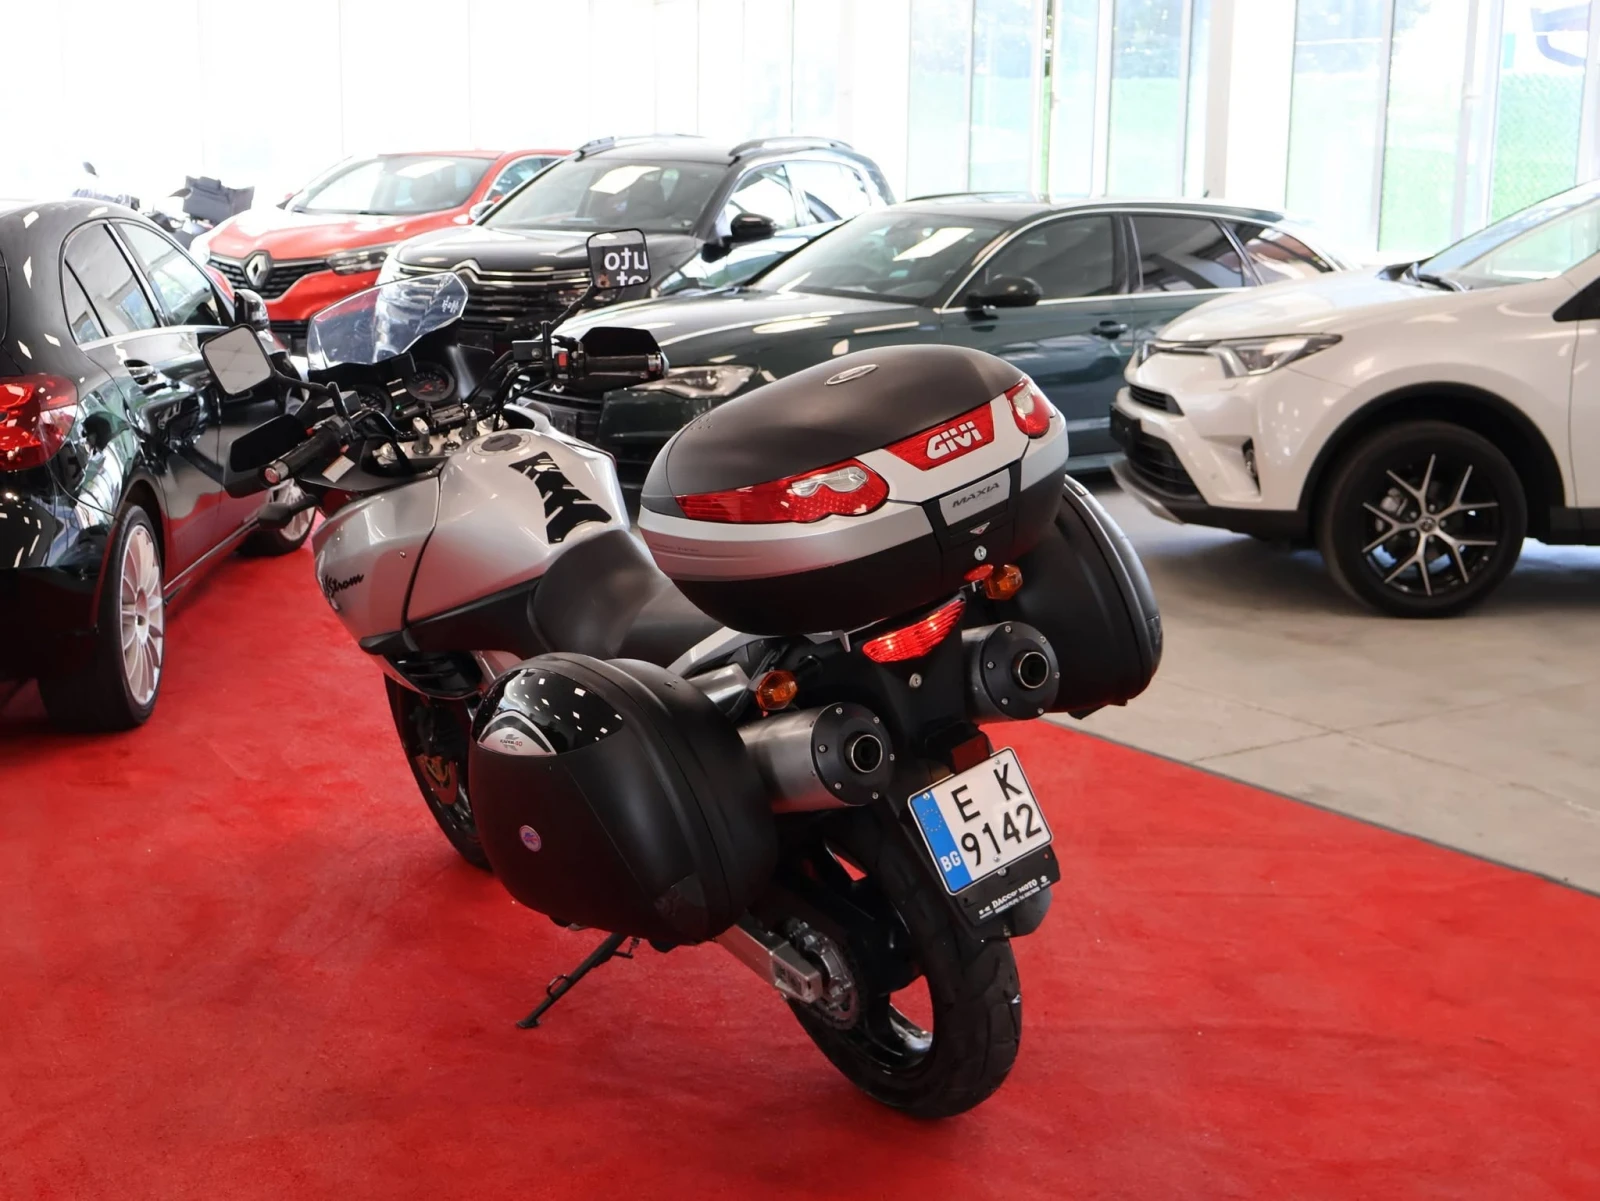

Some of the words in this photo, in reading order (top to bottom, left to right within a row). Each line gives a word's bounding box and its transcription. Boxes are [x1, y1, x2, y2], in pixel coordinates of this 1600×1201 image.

[926, 420, 983, 460] GIVI
[952, 482, 1000, 508] MAXIA
[951, 784, 981, 823] E
[993, 763, 1023, 801] K
[961, 803, 1042, 866] 9142
[940, 850, 961, 872] BG
